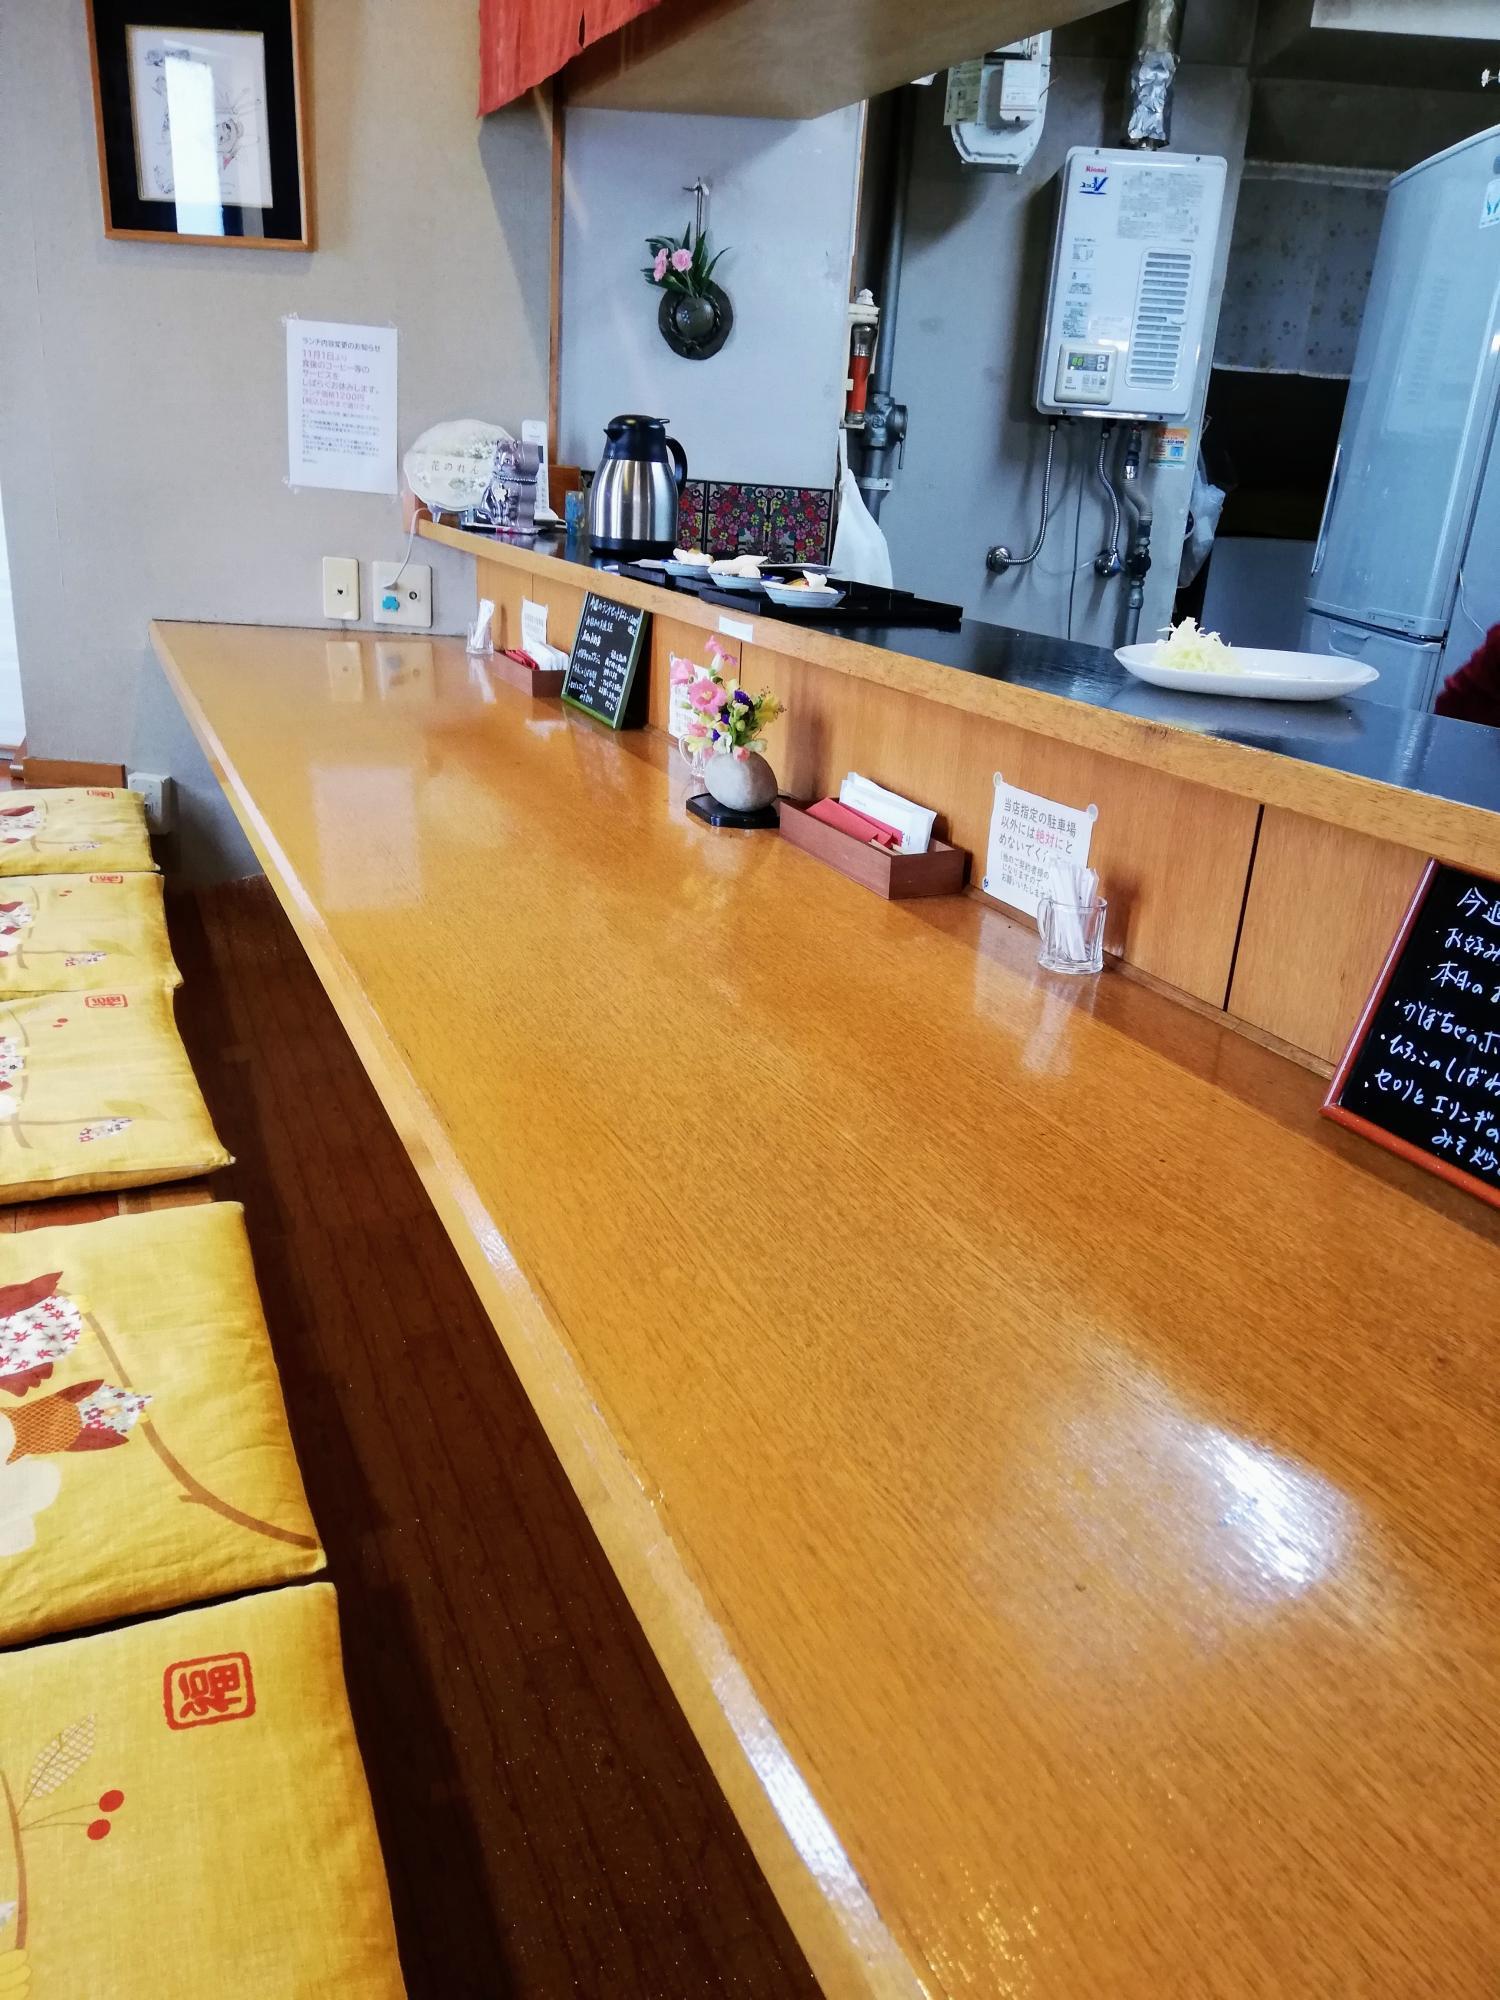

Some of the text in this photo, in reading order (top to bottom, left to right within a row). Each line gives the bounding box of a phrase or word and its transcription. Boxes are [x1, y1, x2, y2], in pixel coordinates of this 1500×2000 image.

[1000, 815, 1074, 855] 以外には絶対にと
[1003, 797, 1077, 839] 当店指定の駐車場
